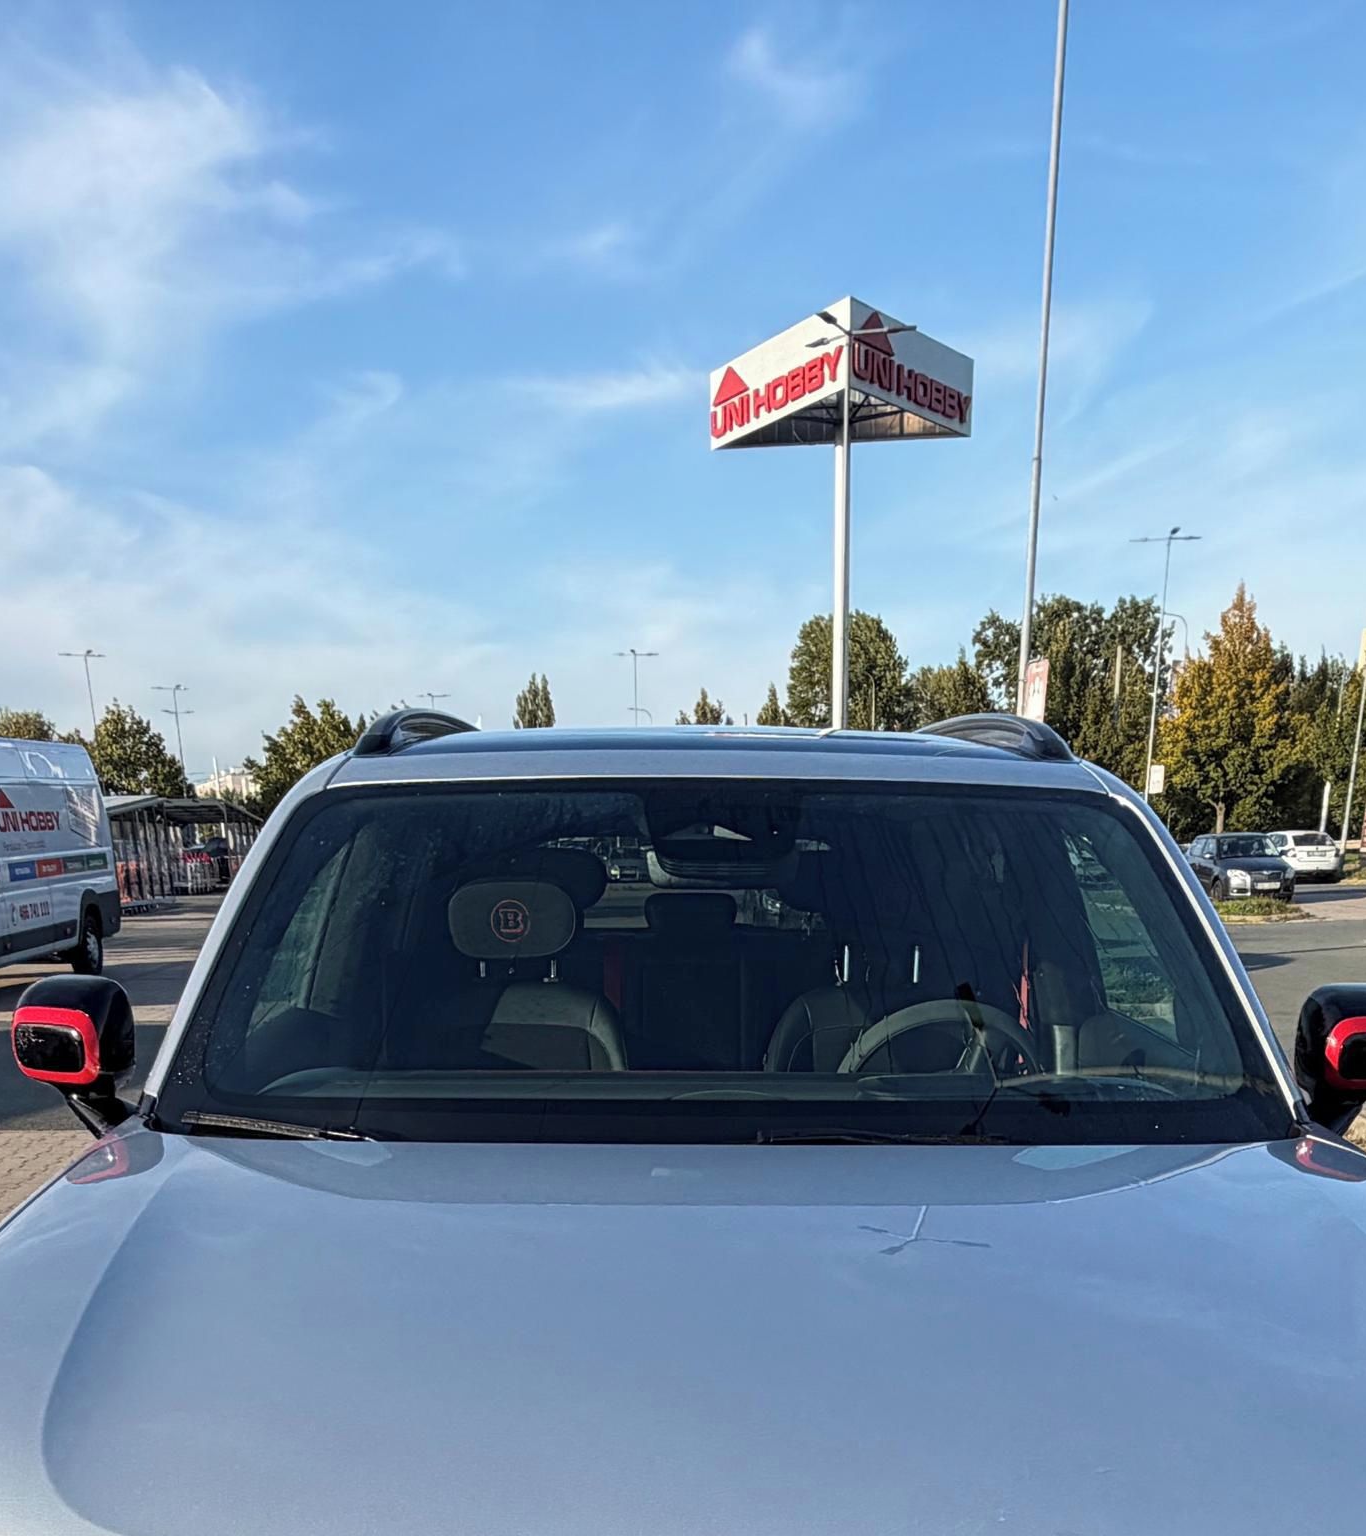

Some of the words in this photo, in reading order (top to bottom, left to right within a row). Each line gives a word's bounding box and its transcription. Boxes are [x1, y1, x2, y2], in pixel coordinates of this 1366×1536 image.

[711, 394, 751, 439] UNI
[753, 345, 844, 418] HOBBY
[852, 343, 895, 392] UNI
[896, 364, 971, 424] HOBBY
[20, 811, 60, 832] HOBBY
